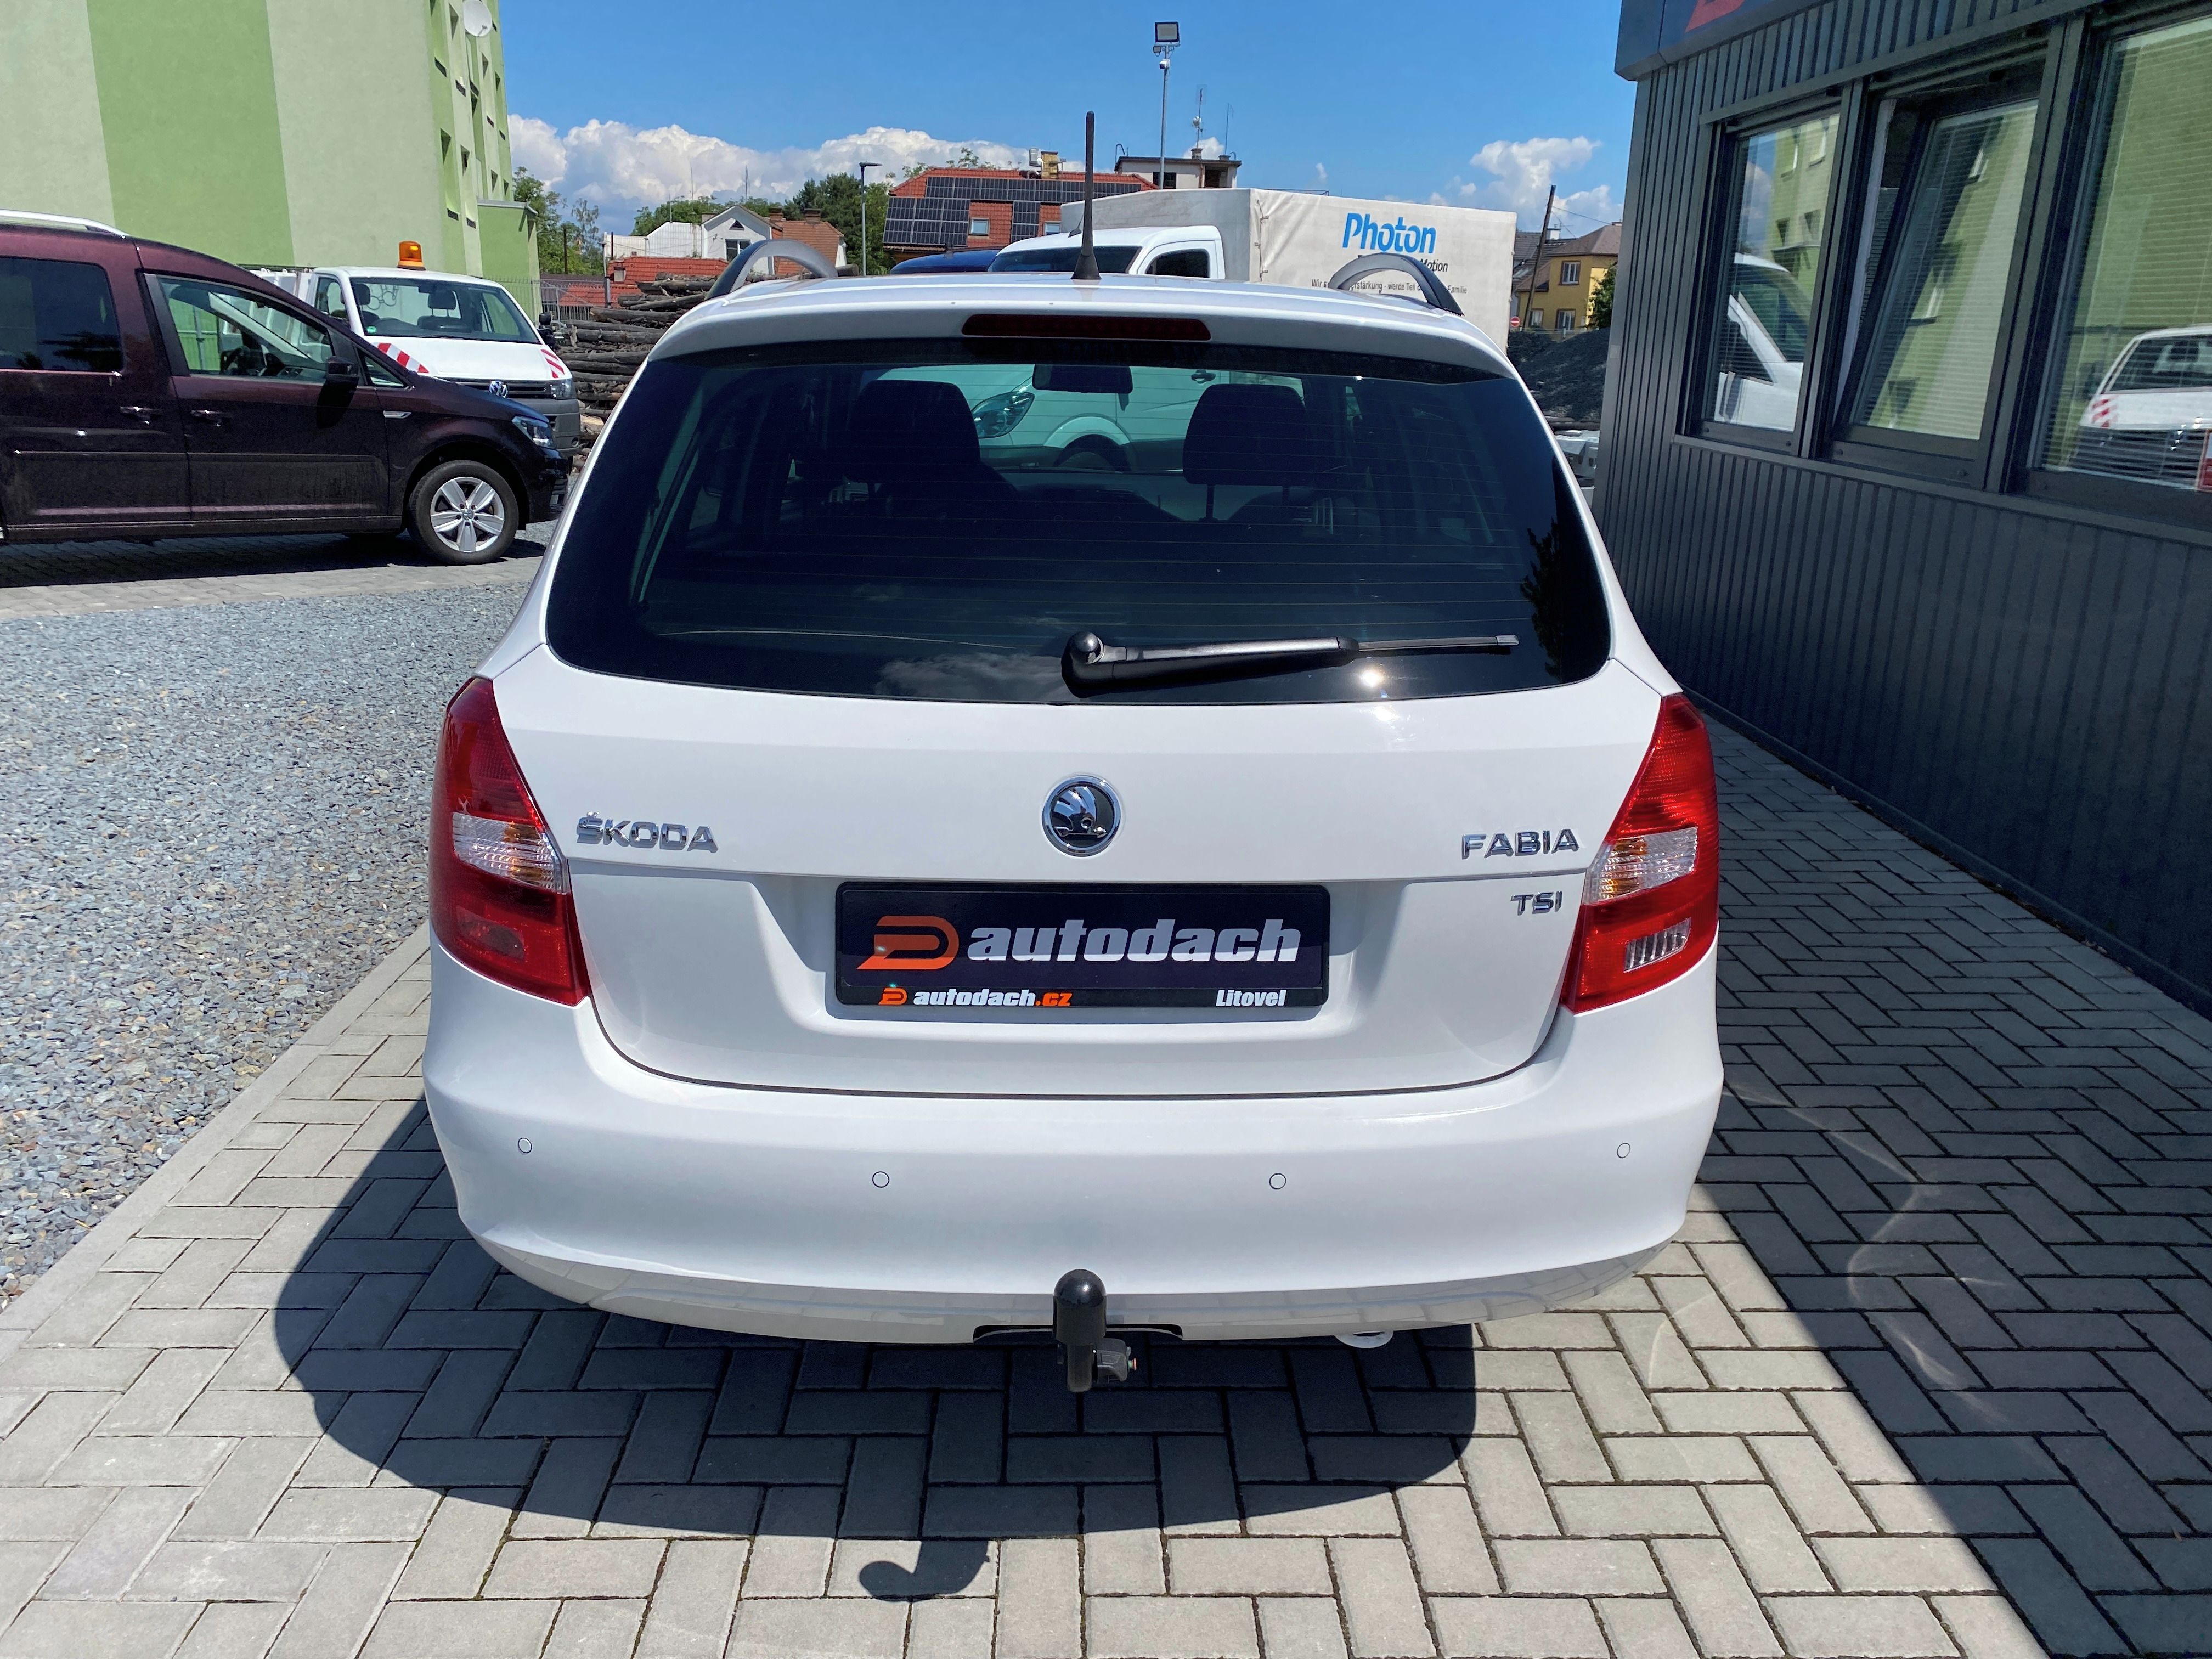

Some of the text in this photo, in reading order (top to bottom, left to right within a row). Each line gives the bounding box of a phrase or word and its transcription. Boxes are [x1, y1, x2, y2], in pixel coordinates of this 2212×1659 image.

[1342, 212, 1436, 254] Photon
[1312, 279, 1322, 287] Wir
[1351, 280, 1383, 294] rstärkung
[1388, 282, 1404, 290] werde
[1407, 283, 1416, 291] Teil
[1447, 285, 1467, 294] Familie
[577, 811, 719, 853] ŠKODA
[1462, 828, 1579, 860] FABIA
[1510, 891, 1562, 916] TSI
[967, 919, 1301, 962] autodach
[913, 988, 1287, 1007] autodach.cz Litovel
